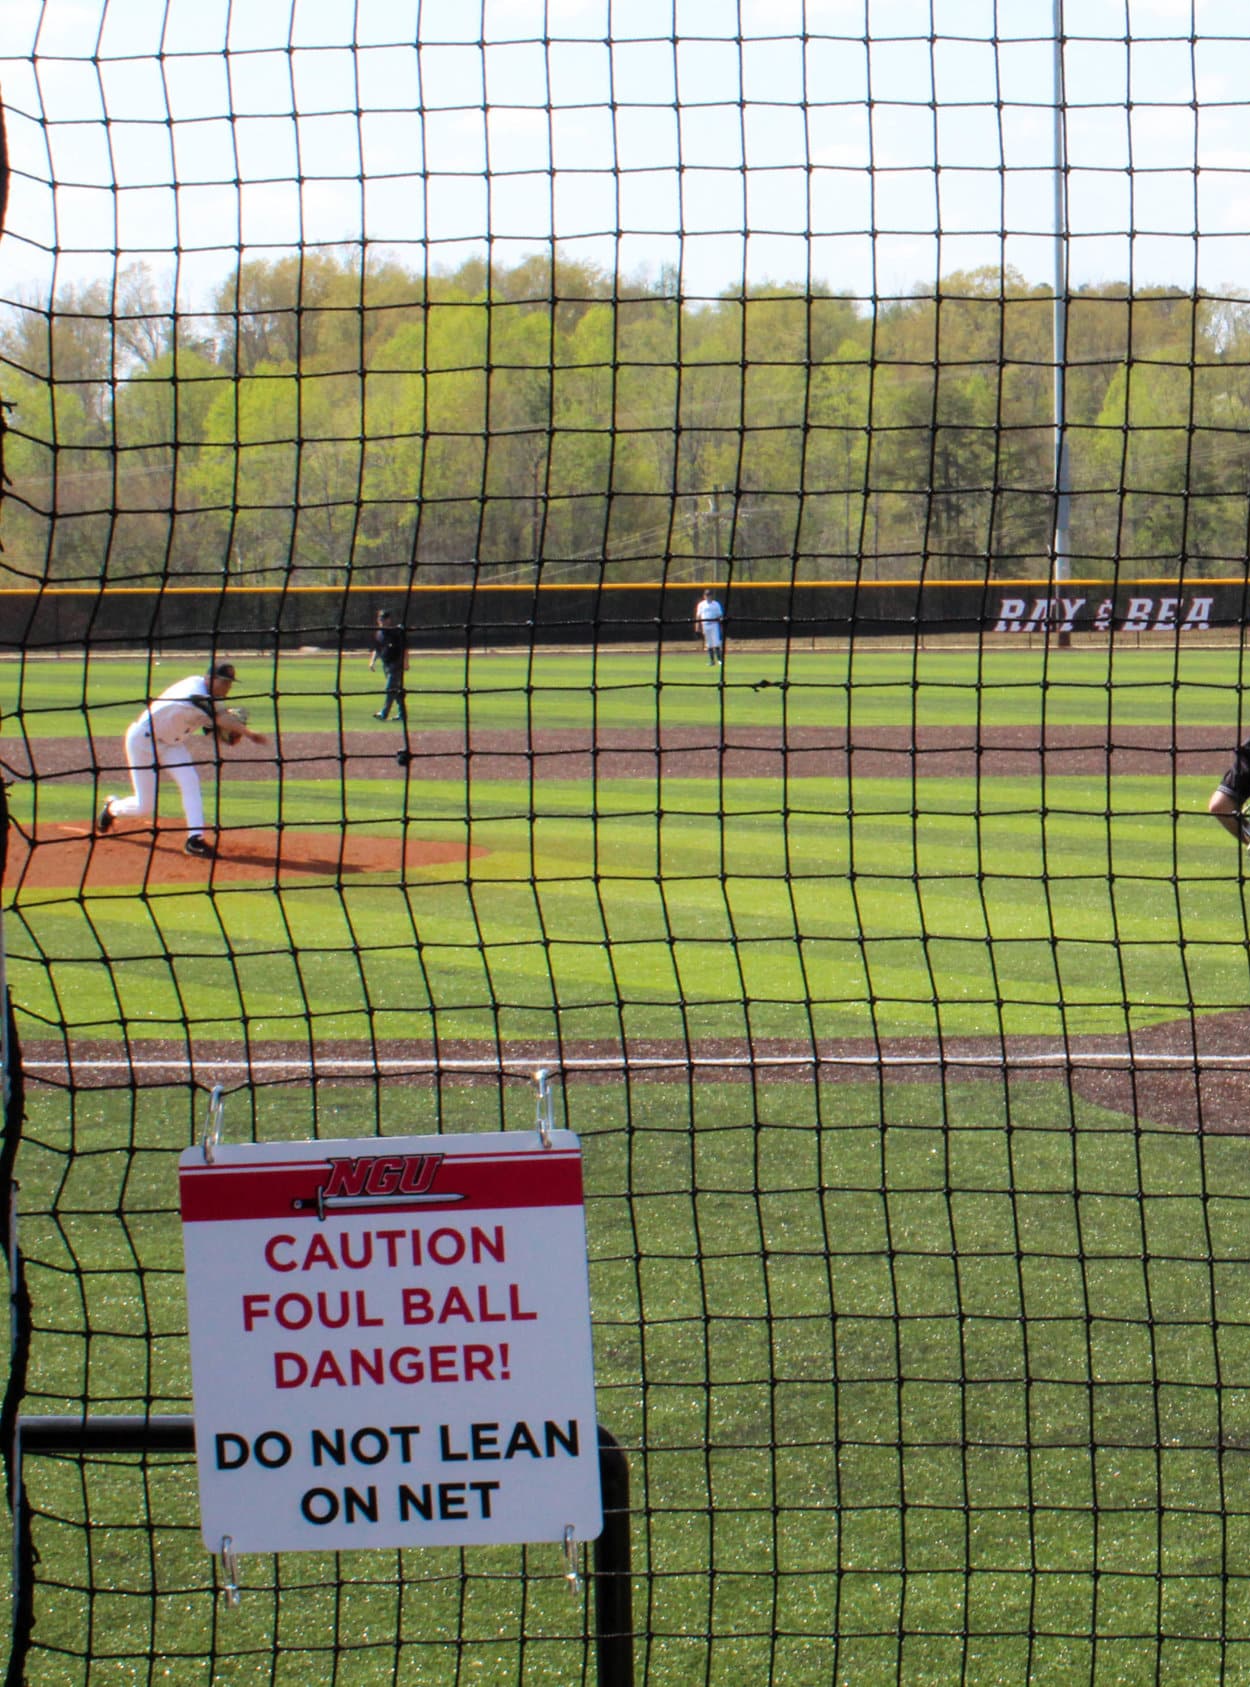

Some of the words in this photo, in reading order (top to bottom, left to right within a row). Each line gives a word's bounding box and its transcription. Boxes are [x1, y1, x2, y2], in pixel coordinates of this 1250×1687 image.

[994, 597, 1086, 632] RAY
[1094, 599, 1113, 631] &
[1121, 597, 1214, 631] BEA
[324, 1153, 444, 1197] NGU
[264, 1226, 505, 1272] CAUTION
[243, 1290, 383, 1331] FOUL
[402, 1284, 537, 1325] BALL
[274, 1344, 510, 1389] DANGER!
[216, 1430, 291, 1470] DO
[312, 1426, 420, 1466] NOT
[440, 1420, 579, 1461] LEAN
[301, 1485, 378, 1525] ON
[399, 1481, 499, 1521] NET
